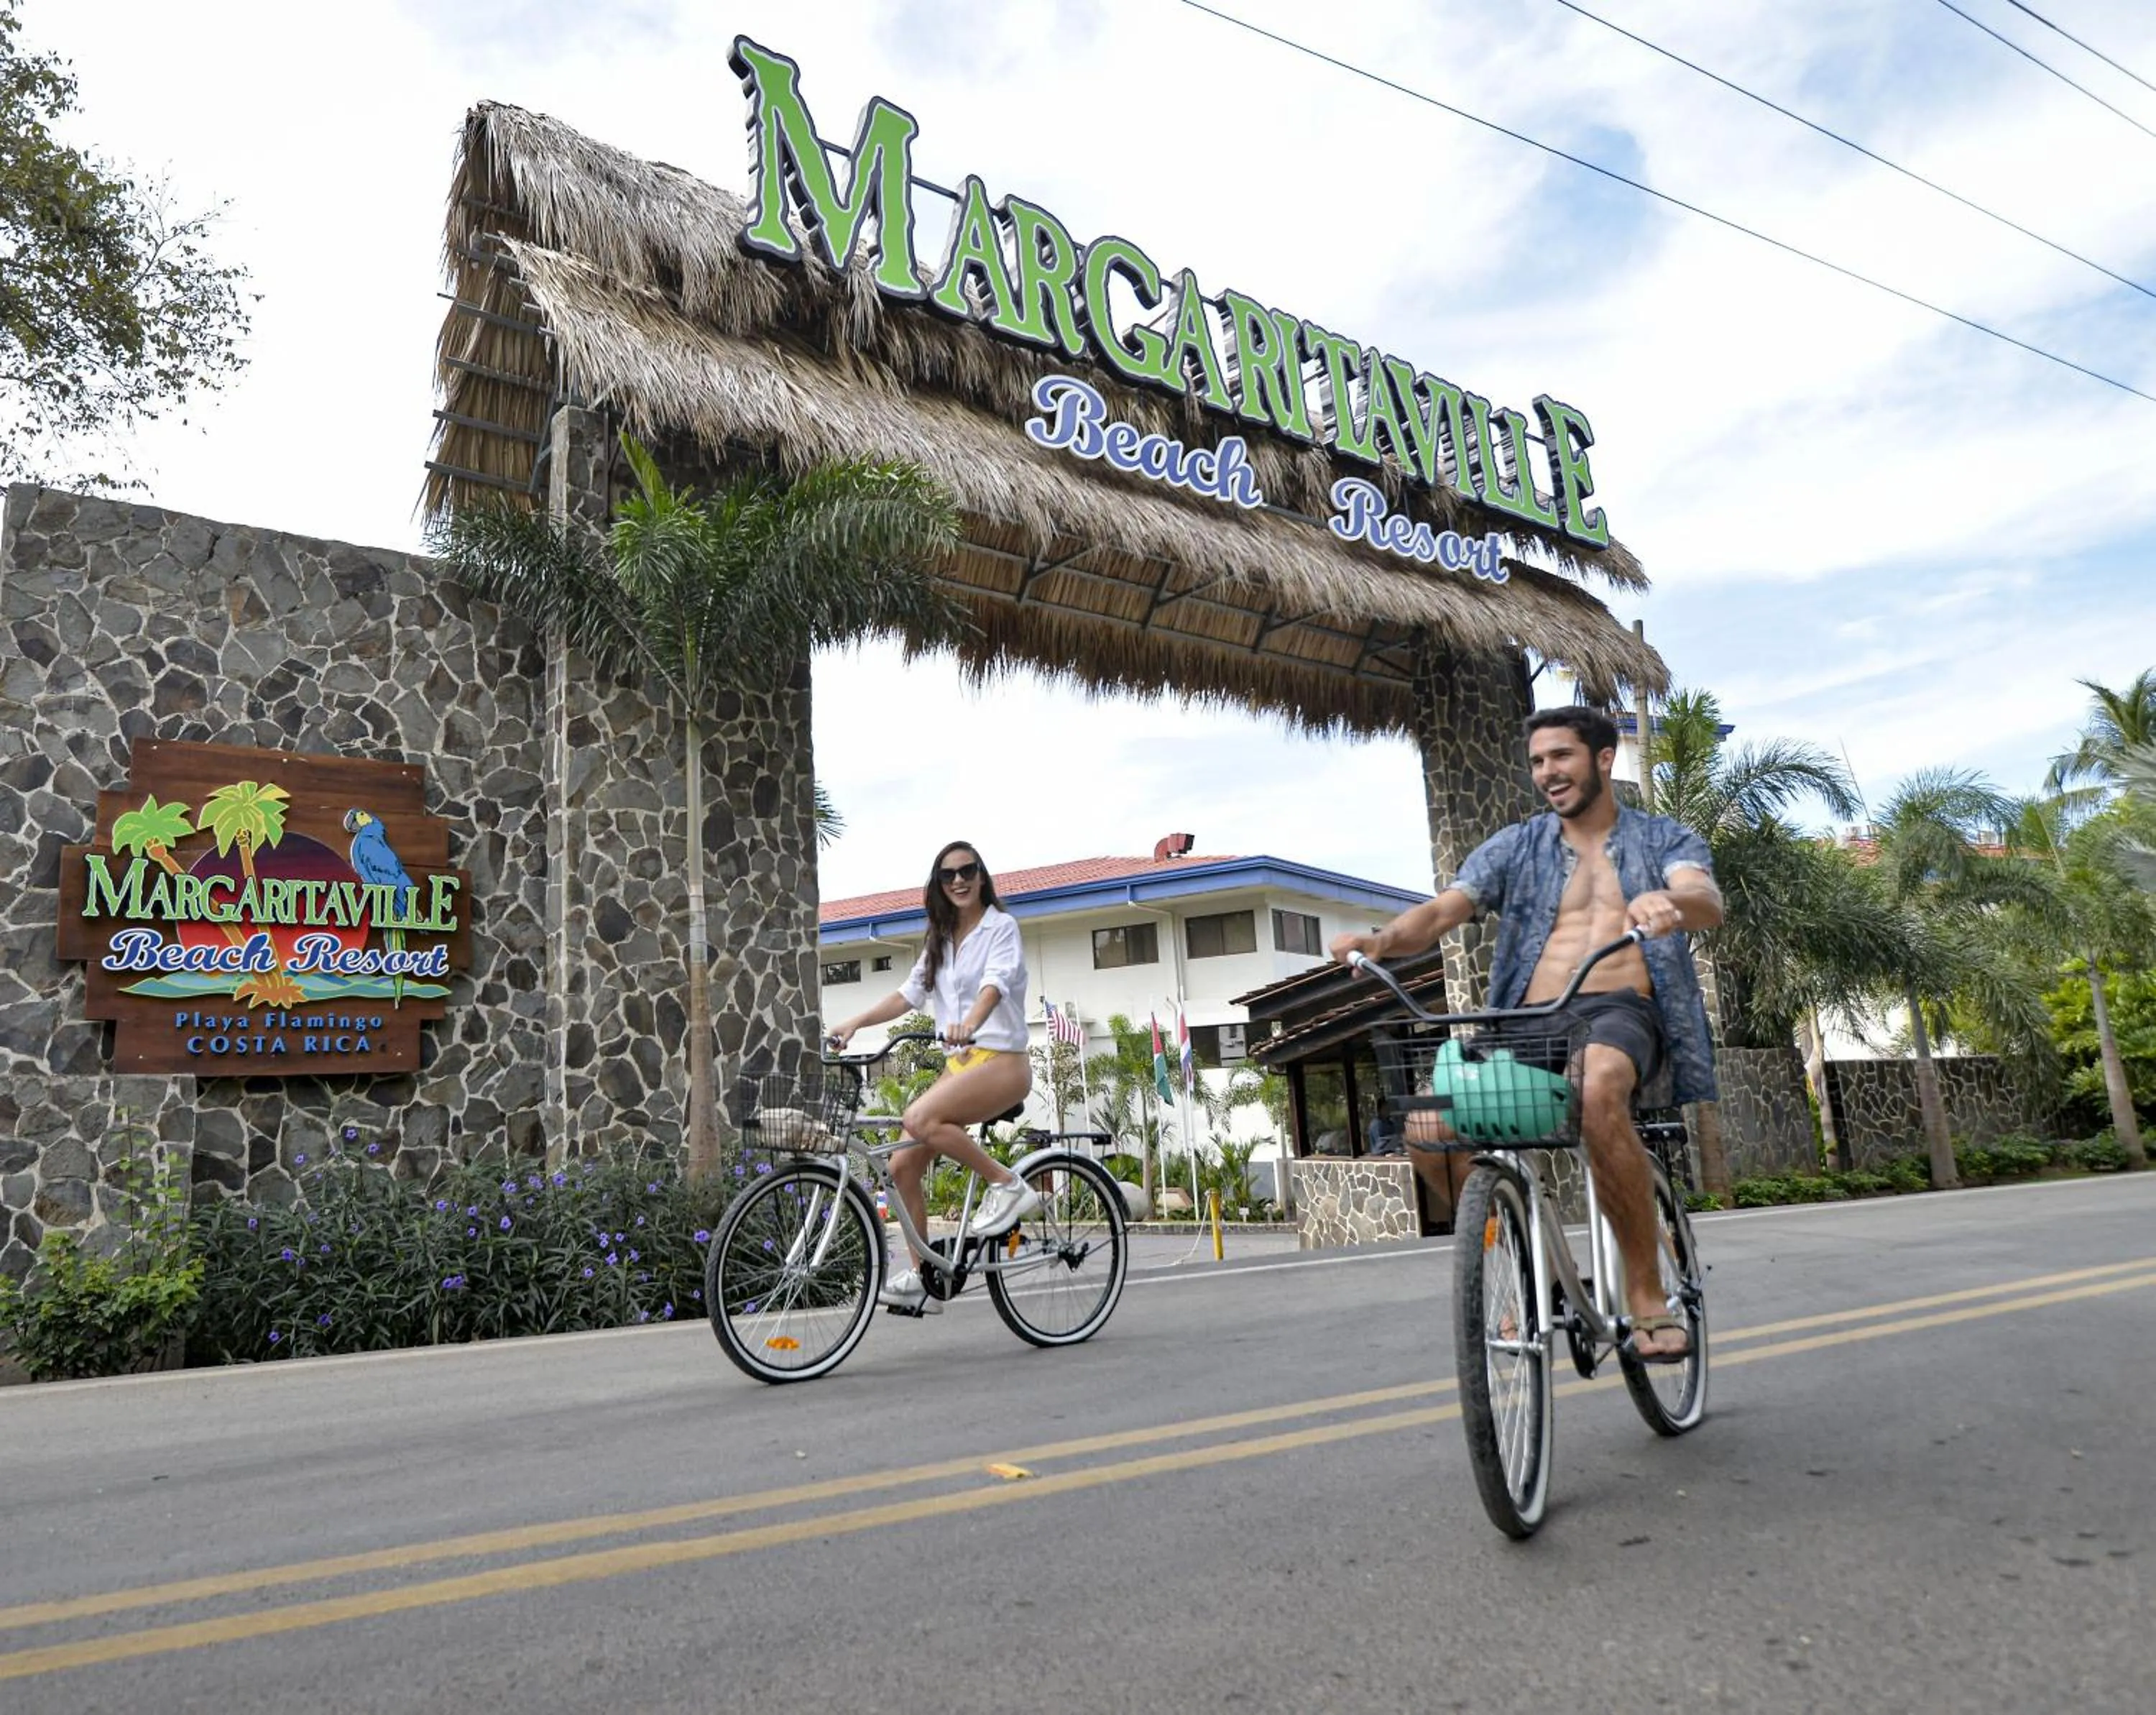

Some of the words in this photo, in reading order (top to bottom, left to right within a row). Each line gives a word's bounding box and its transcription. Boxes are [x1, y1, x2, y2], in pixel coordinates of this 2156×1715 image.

[730, 35, 1610, 549] MARGARITAVILLE
[1025, 374, 1263, 510] Beach
[1327, 476, 1510, 585] Resort
[82, 853, 461, 932] MARGARITAVILLE
[102, 928, 275, 972] Beach
[287, 933, 449, 976] Resort
[175, 1011, 249, 1034] Playa
[264, 1012, 383, 1032] Flamingo
[187, 1035, 287, 1054] COSTA
[304, 1036, 372, 1052] RICA
